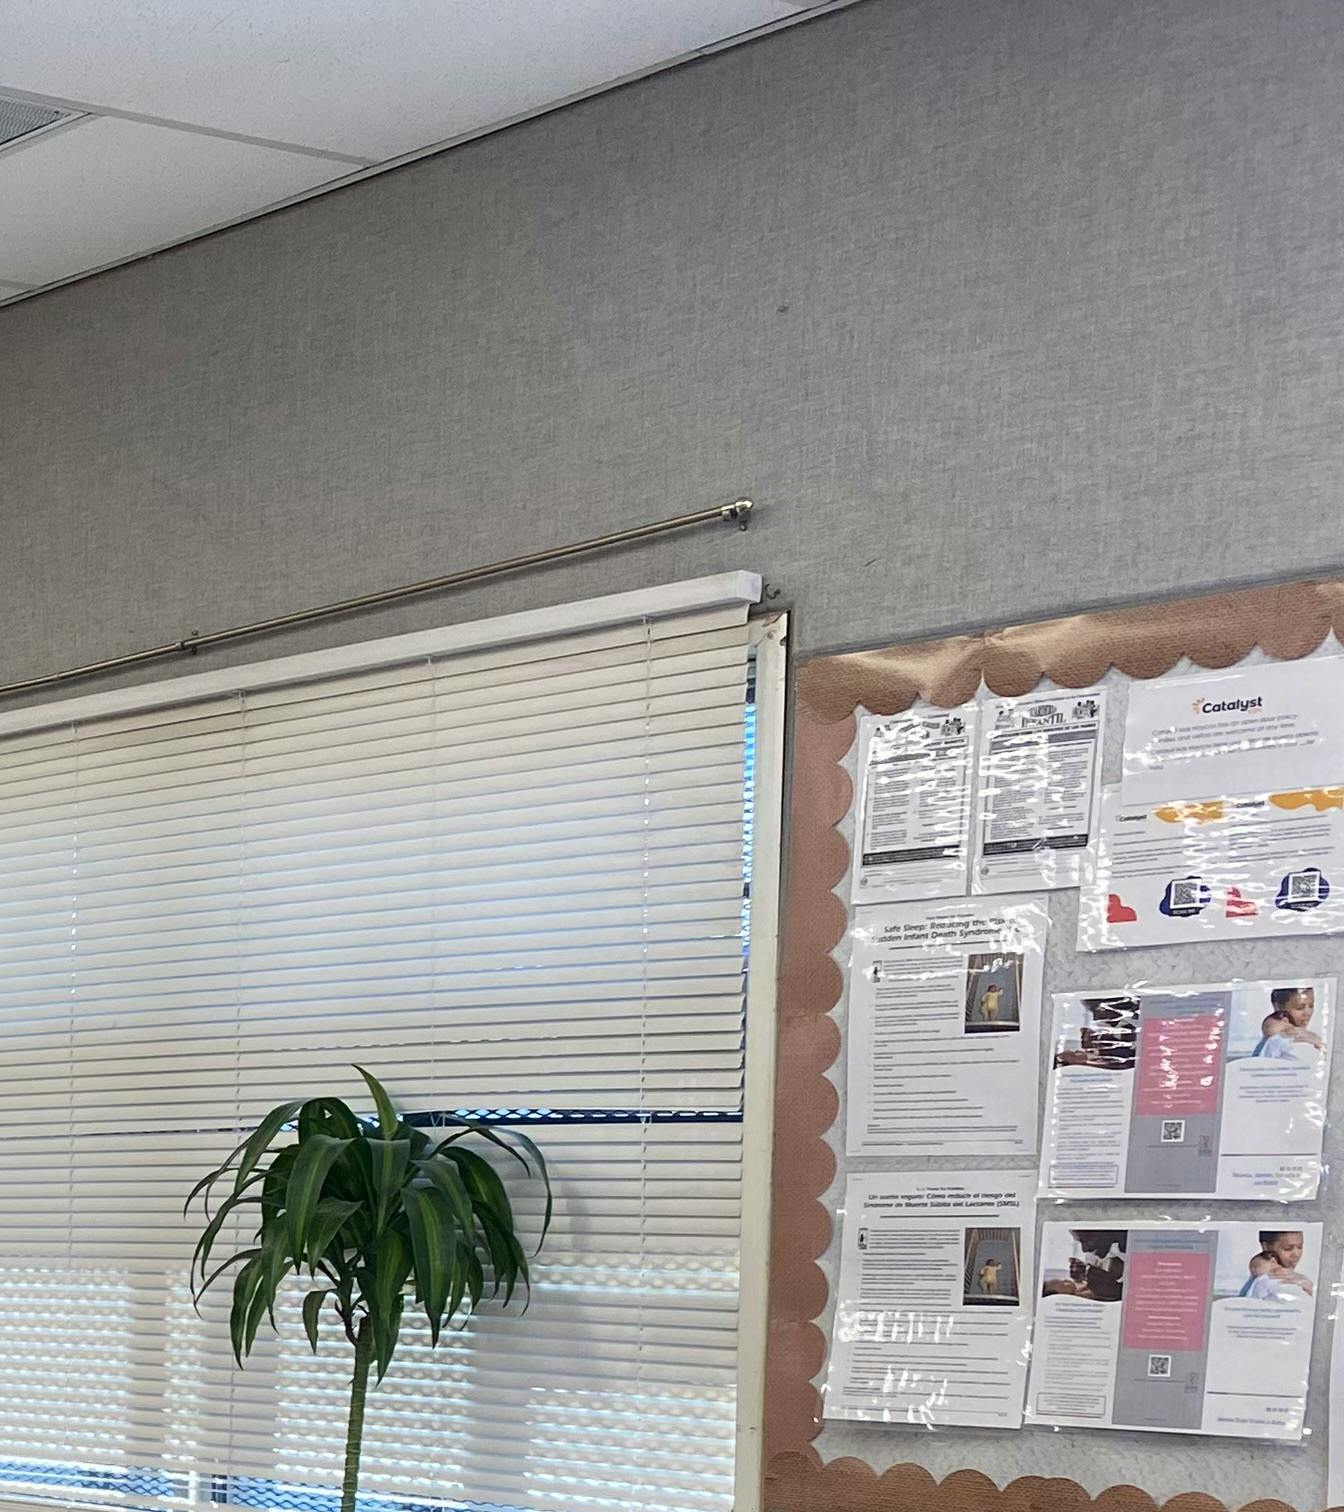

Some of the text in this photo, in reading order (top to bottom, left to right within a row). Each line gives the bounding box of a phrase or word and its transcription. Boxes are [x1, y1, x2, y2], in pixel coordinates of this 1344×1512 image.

[1202, 696, 1263, 714] Catalyst
[884, 925, 901, 933] Safe
[903, 931, 929, 941] Infant
[931, 929, 957, 939] Death
